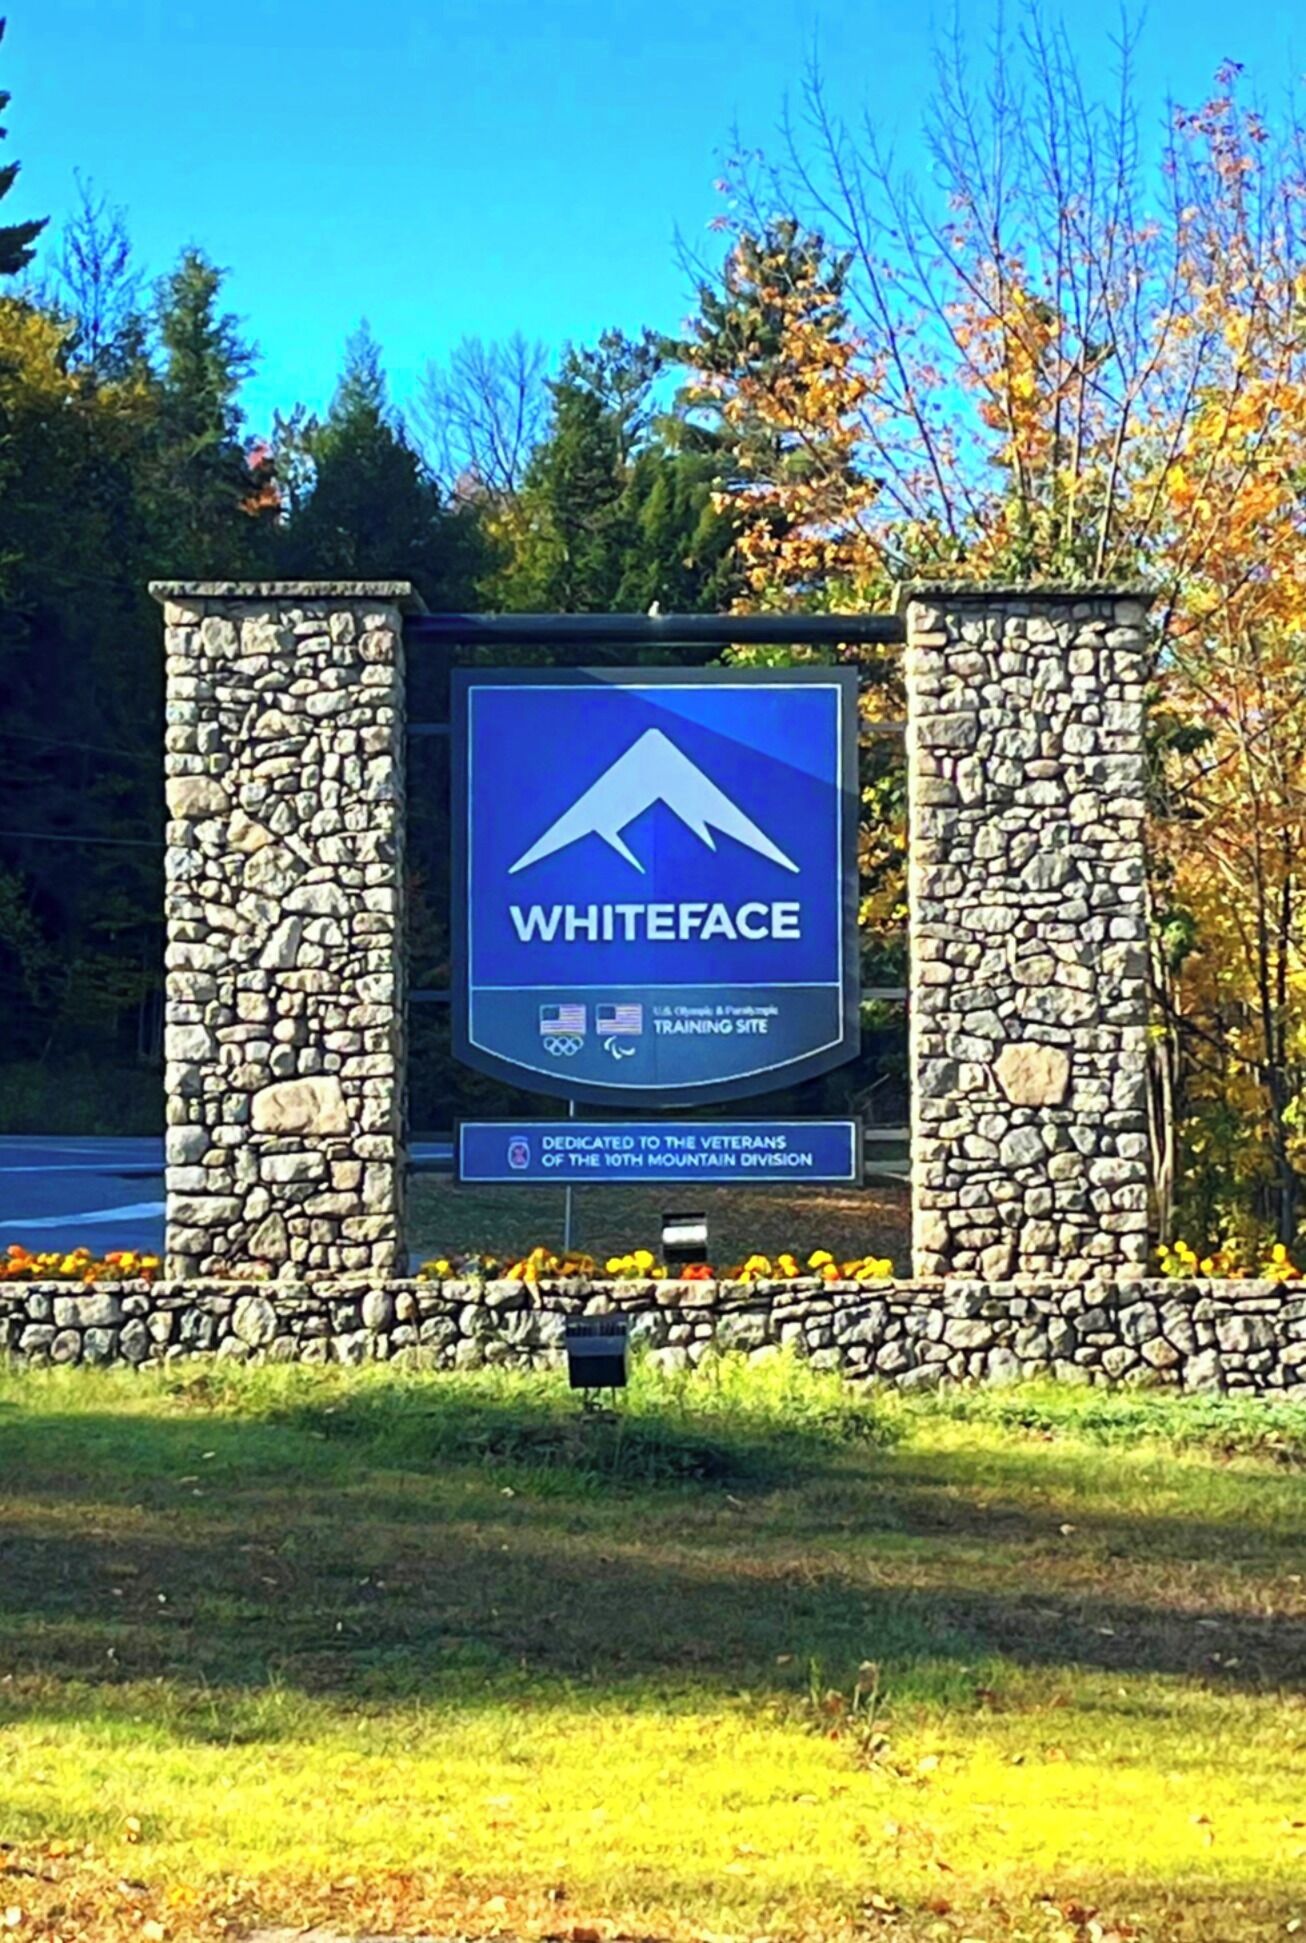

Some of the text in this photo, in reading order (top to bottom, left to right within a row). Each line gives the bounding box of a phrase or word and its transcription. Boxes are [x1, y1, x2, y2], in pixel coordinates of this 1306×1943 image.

[509, 902, 801, 941] WHITEFACE
[654, 1018, 768, 1034] TRAINING SITE
[541, 1135, 787, 1150] DEDICATED TO THE VETERANS
[541, 1152, 813, 1168] OF THE 10TH MOUNTAIN DIVISION
